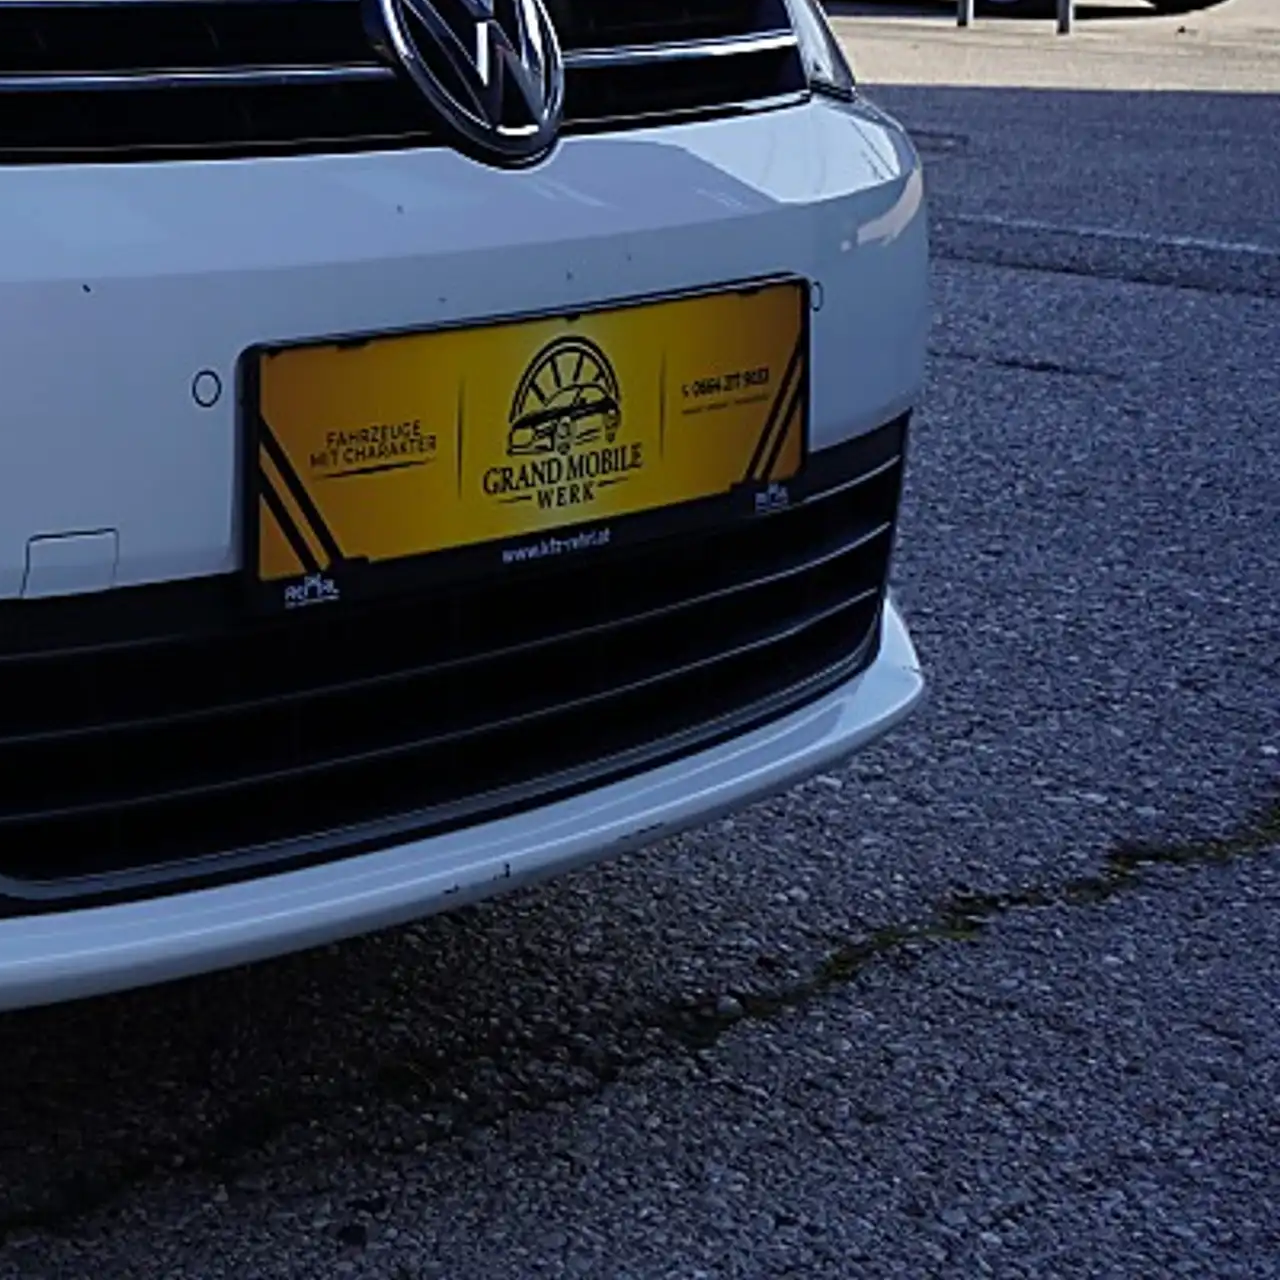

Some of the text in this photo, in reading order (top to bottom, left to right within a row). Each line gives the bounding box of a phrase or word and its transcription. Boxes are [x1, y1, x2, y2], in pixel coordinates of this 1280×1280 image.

[325, 418, 421, 448] FAHRZEUGE
[343, 433, 437, 464] CHARAKTER
[482, 442, 643, 495] GRAND MOBILE
[536, 481, 595, 508] WERK
